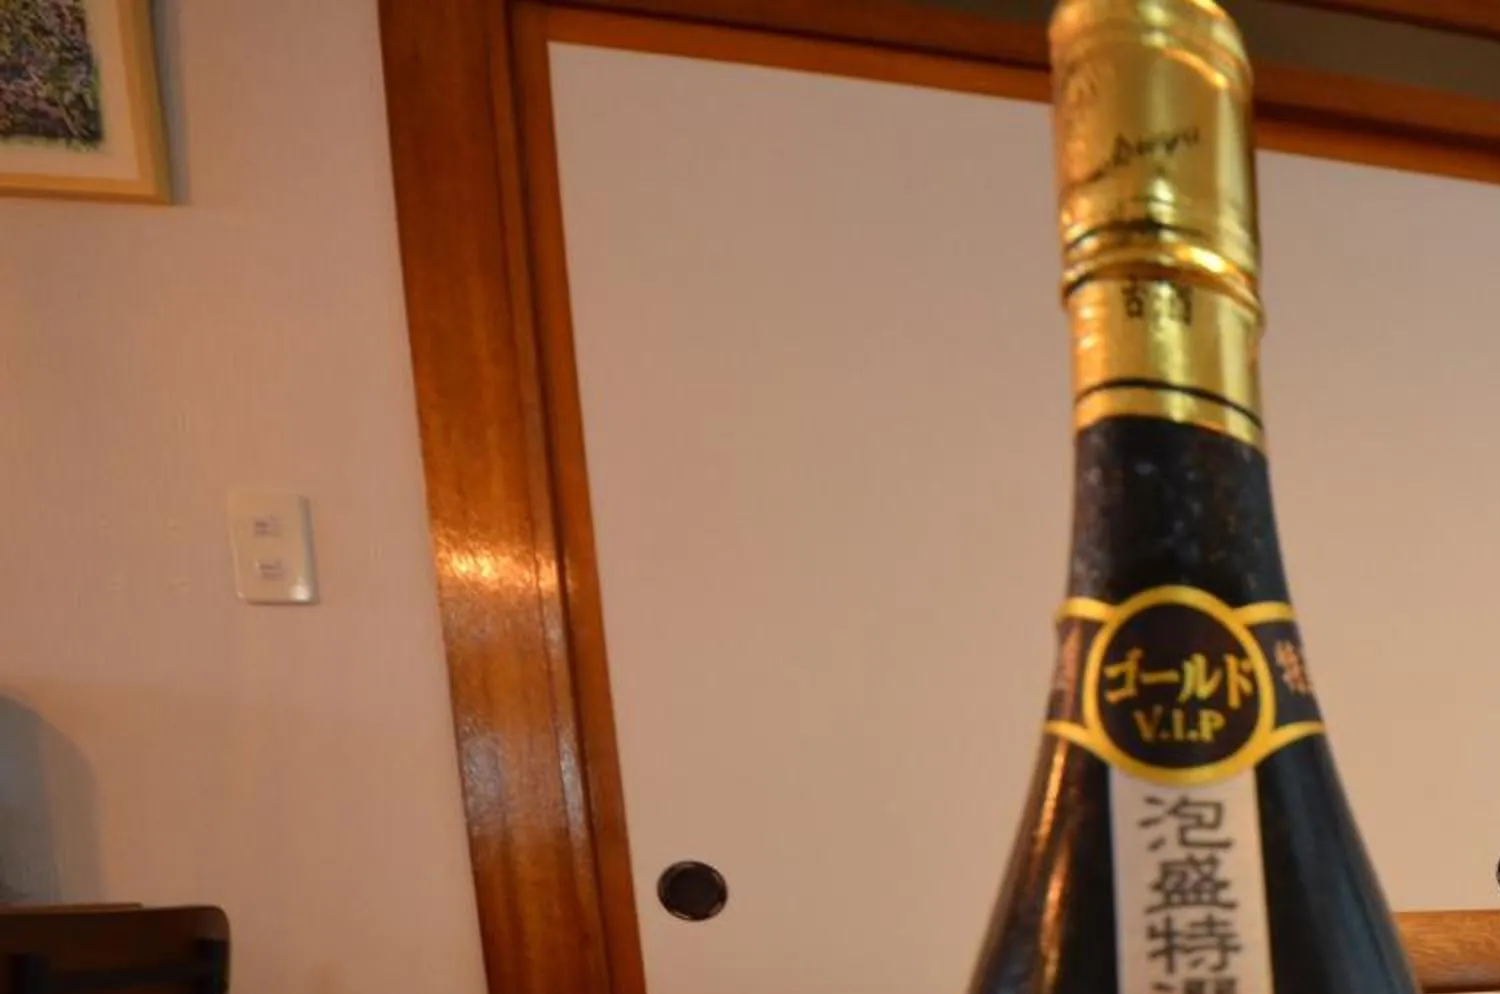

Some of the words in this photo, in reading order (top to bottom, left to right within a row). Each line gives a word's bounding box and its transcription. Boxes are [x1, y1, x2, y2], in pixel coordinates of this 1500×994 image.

[1104, 648, 1253, 709] ゴールド
[1133, 705, 1225, 742] V.I.P
